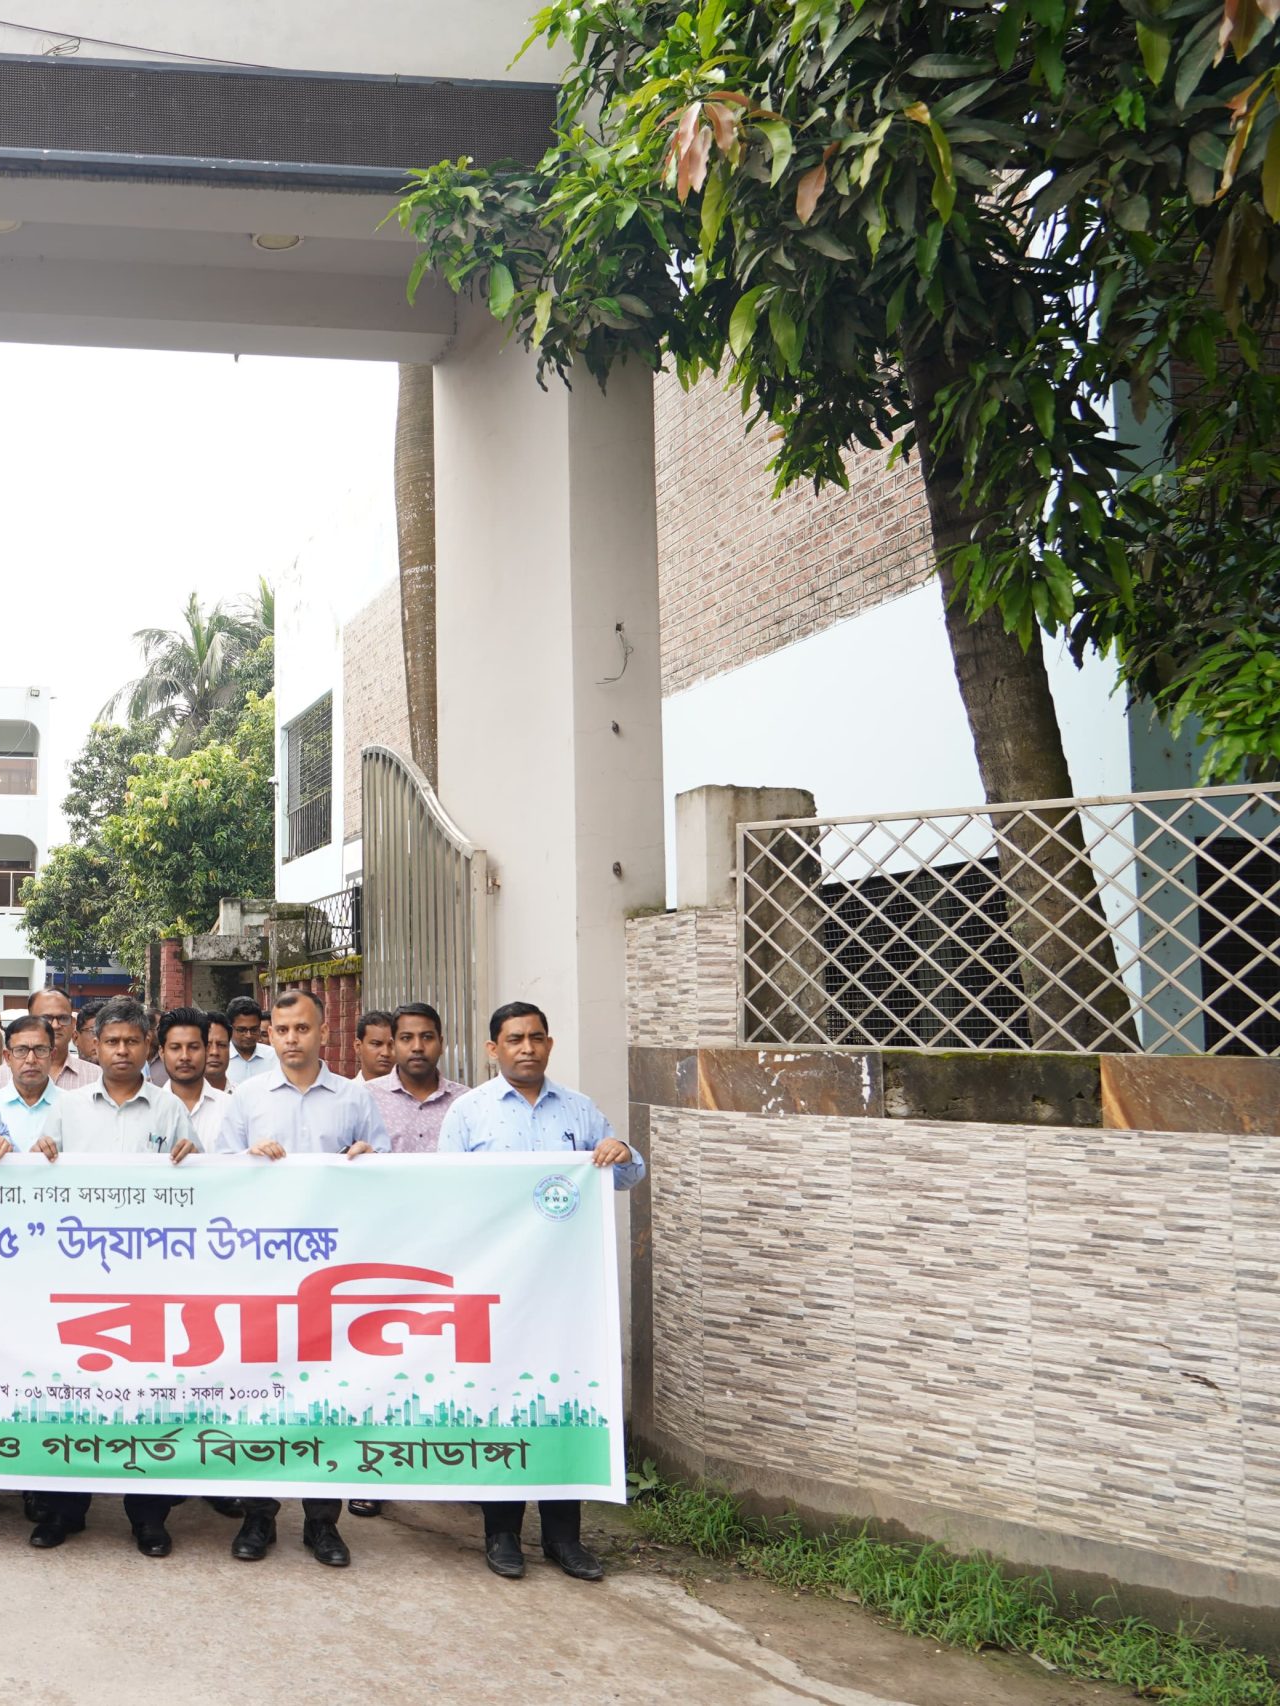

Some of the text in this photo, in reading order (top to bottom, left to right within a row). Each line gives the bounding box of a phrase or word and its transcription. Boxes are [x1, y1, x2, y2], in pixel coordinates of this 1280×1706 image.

[33, 1186, 71, 1204] নগর
[78, 1186, 147, 1209] সমস্যায়
[153, 1184, 195, 1208] সাড়া
[206, 1216, 340, 1263] উপলক্ষে
[24, 1387, 43, 1399] ০৬
[46, 1384, 91, 1401] অক্টোবর
[95, 1387, 131, 1401] ২০২৫
[150, 1387, 177, 1401] সময়
[190, 1386, 224, 1401] সকাল
[229, 1387, 269, 1400] ১০:০০
[273, 1382, 286, 1401] টা
[42, 1428, 181, 1474] গণপূর্ত
[194, 1430, 338, 1473] বিভাগ,
[355, 1438, 531, 1477] চুয়াডাঙ্গা
